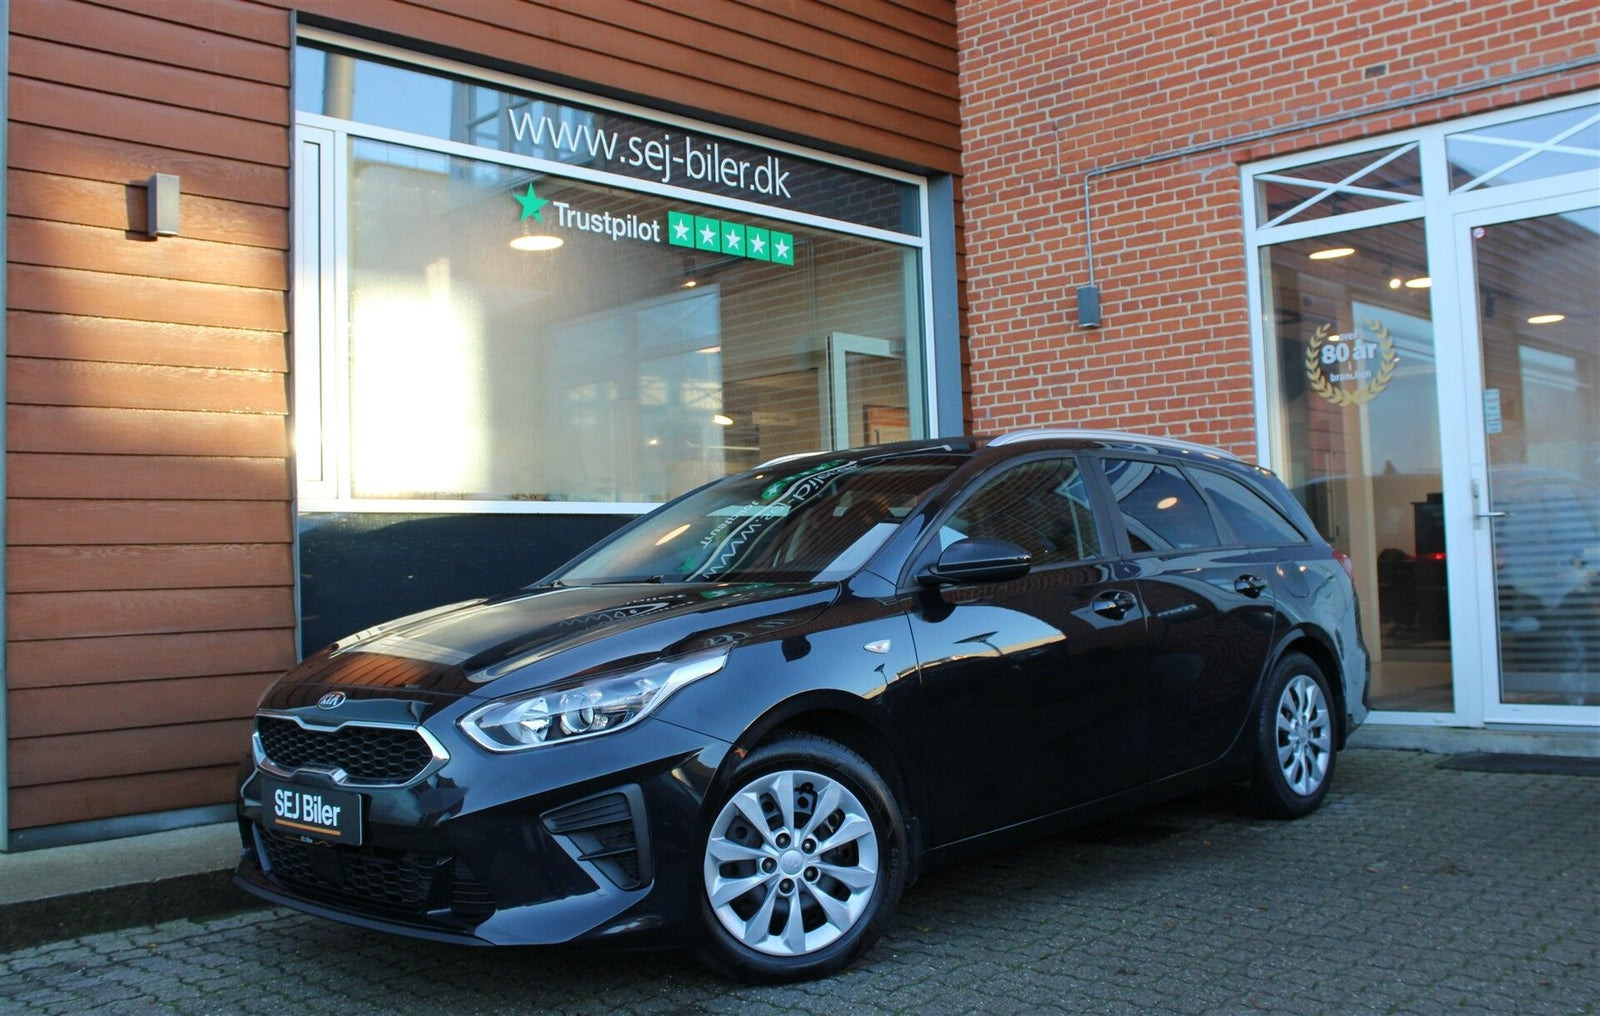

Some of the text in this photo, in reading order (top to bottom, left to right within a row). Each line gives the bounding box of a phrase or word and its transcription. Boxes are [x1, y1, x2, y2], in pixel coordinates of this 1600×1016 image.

[508, 108, 792, 199] www.sej-biler.dk
[553, 200, 660, 243] Trustpilot
[1321, 342, 1350, 365] 80
[274, 788, 341, 827] SEJ Biler
